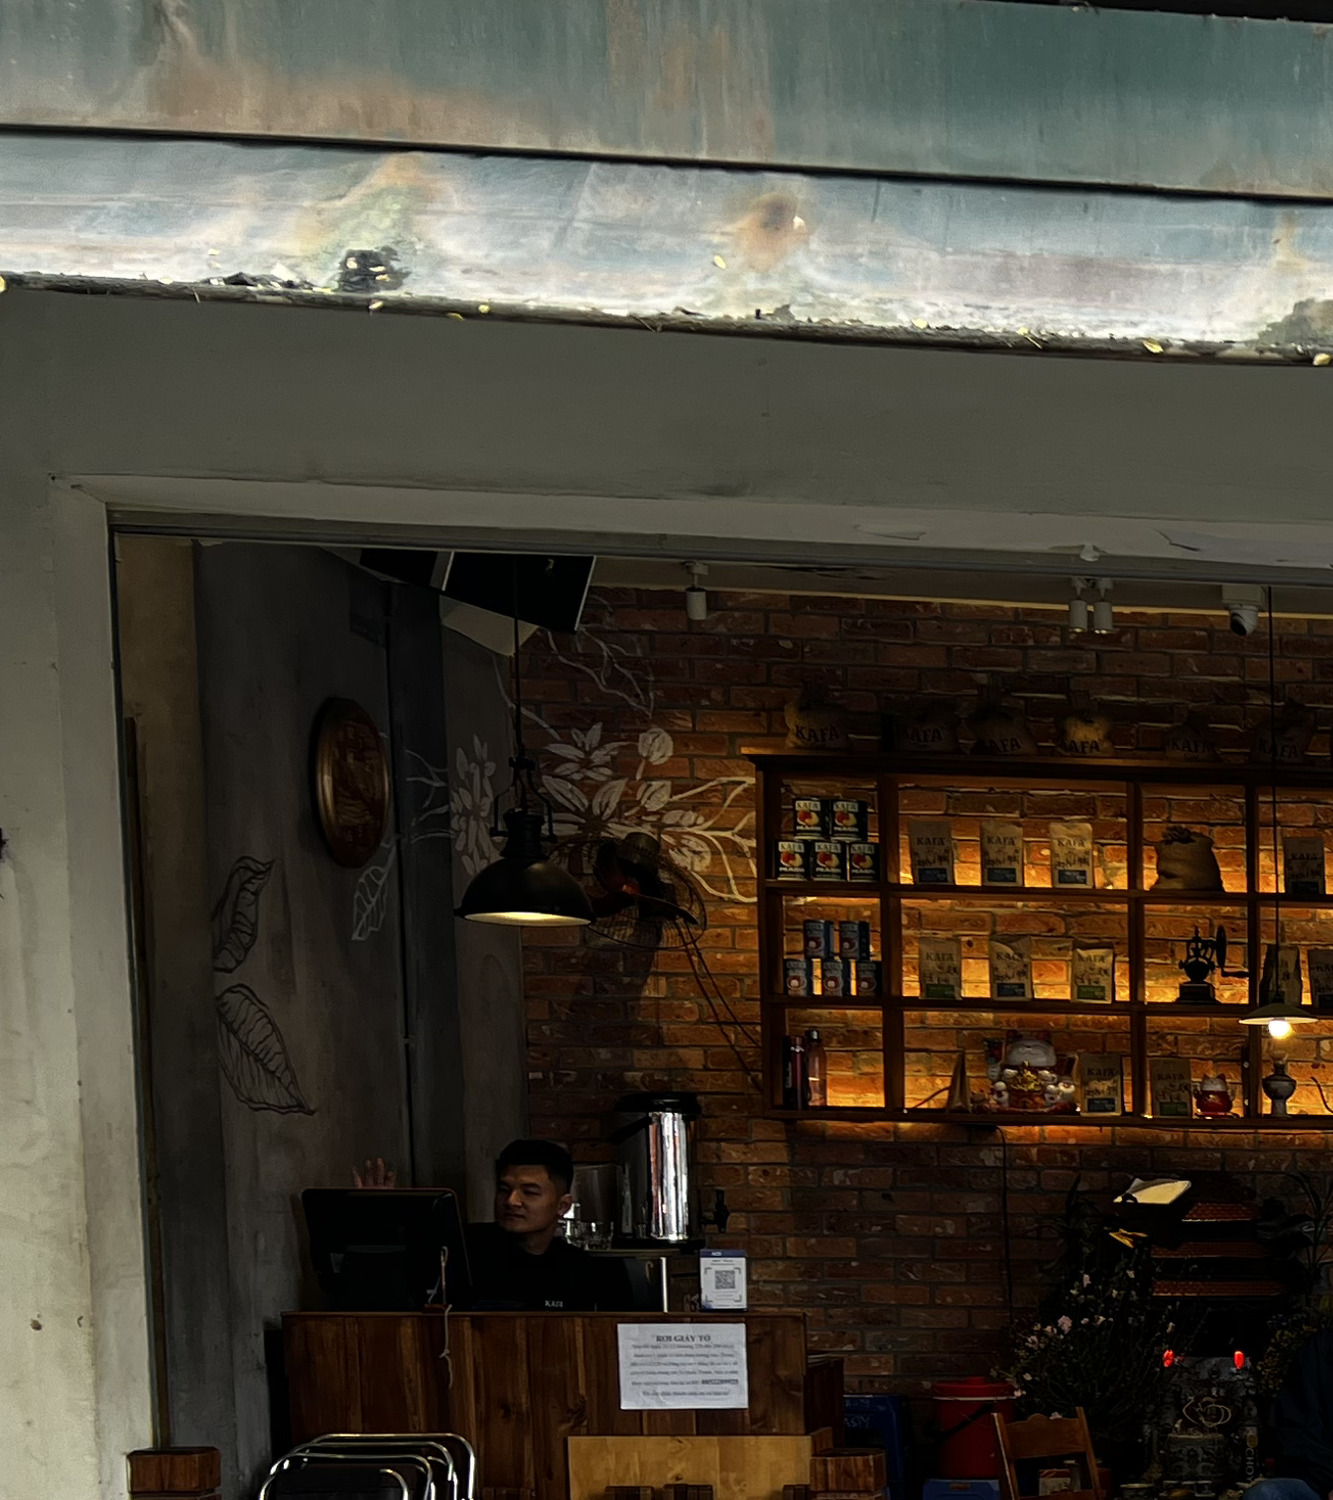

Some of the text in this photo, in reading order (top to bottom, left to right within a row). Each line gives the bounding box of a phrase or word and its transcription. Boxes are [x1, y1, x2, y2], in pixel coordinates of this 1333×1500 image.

[795, 725, 839, 741] KAFA
[916, 837, 945, 846] KAFA
[986, 835, 1016, 846] KAFA
